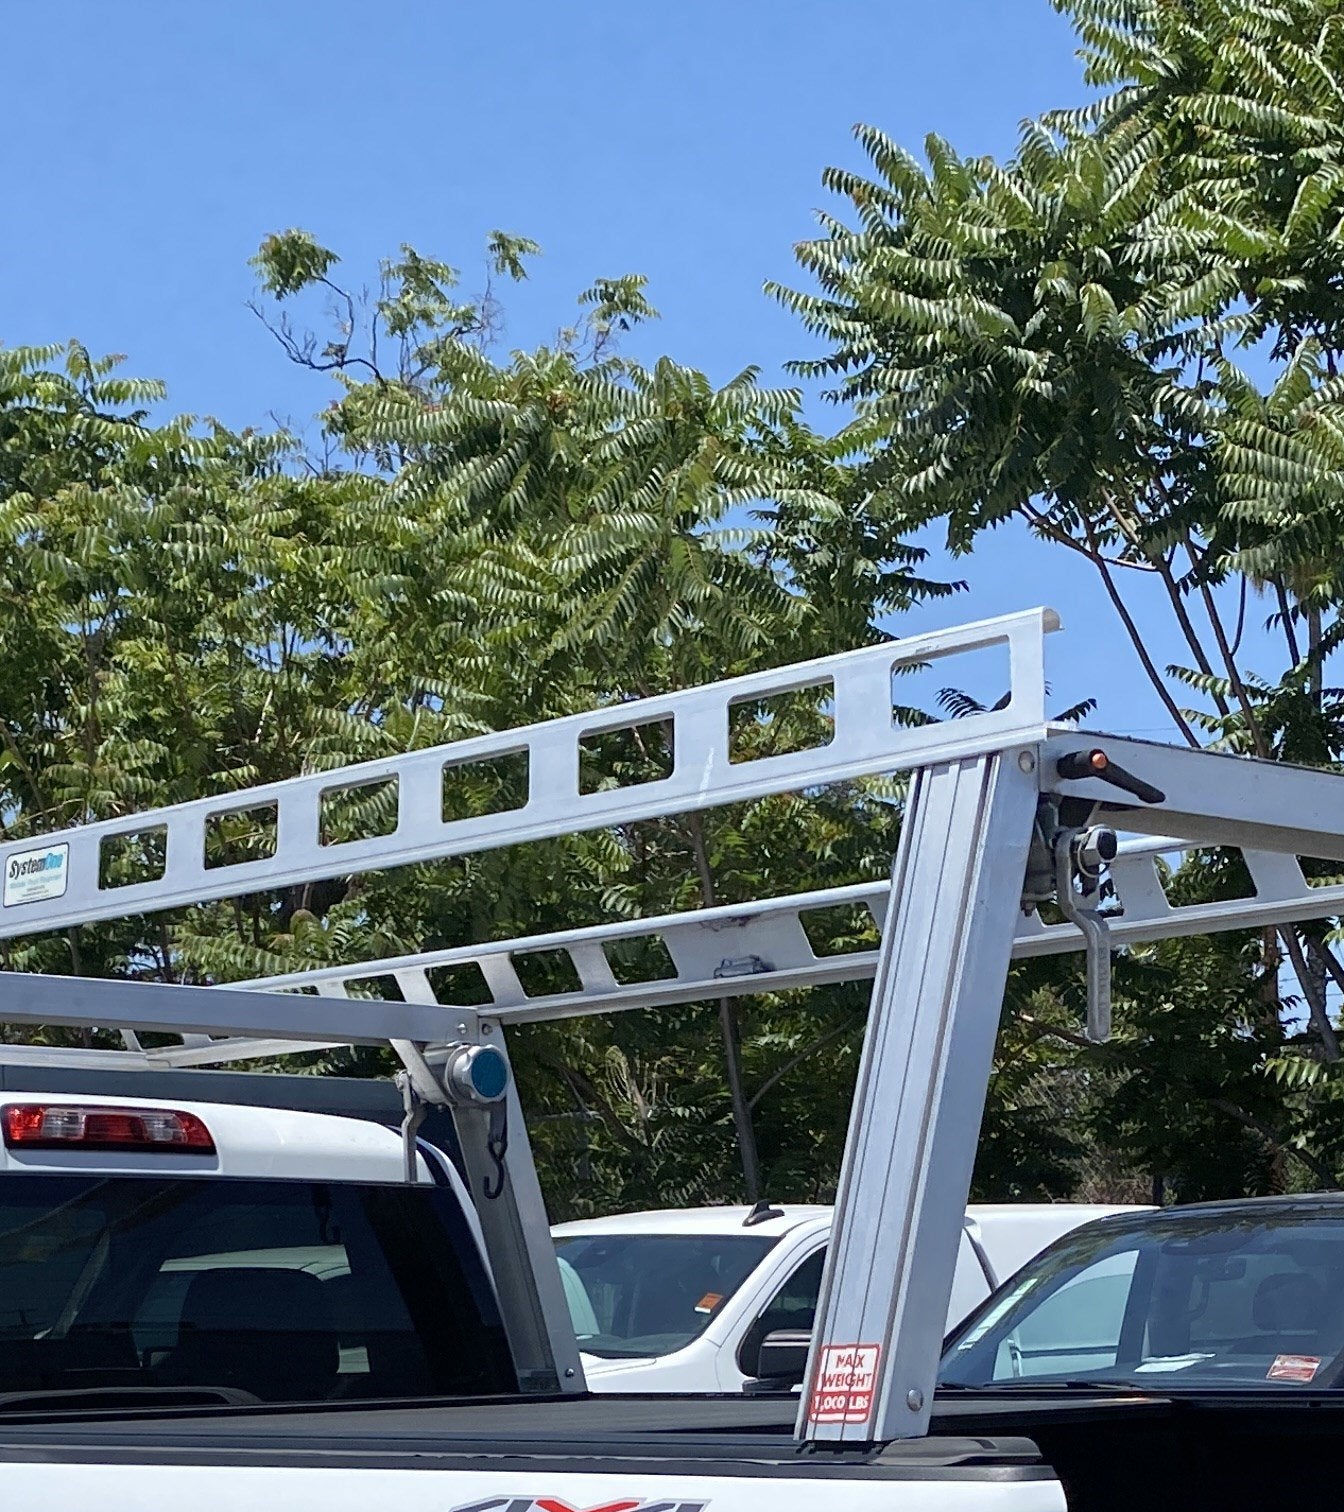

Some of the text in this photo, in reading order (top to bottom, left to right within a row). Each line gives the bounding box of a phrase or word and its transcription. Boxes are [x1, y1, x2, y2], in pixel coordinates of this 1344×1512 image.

[836, 1354, 865, 1368] MAX
[822, 1373, 872, 1387] WEIGHT
[815, 1395, 870, 1411] 1,000 LBS
